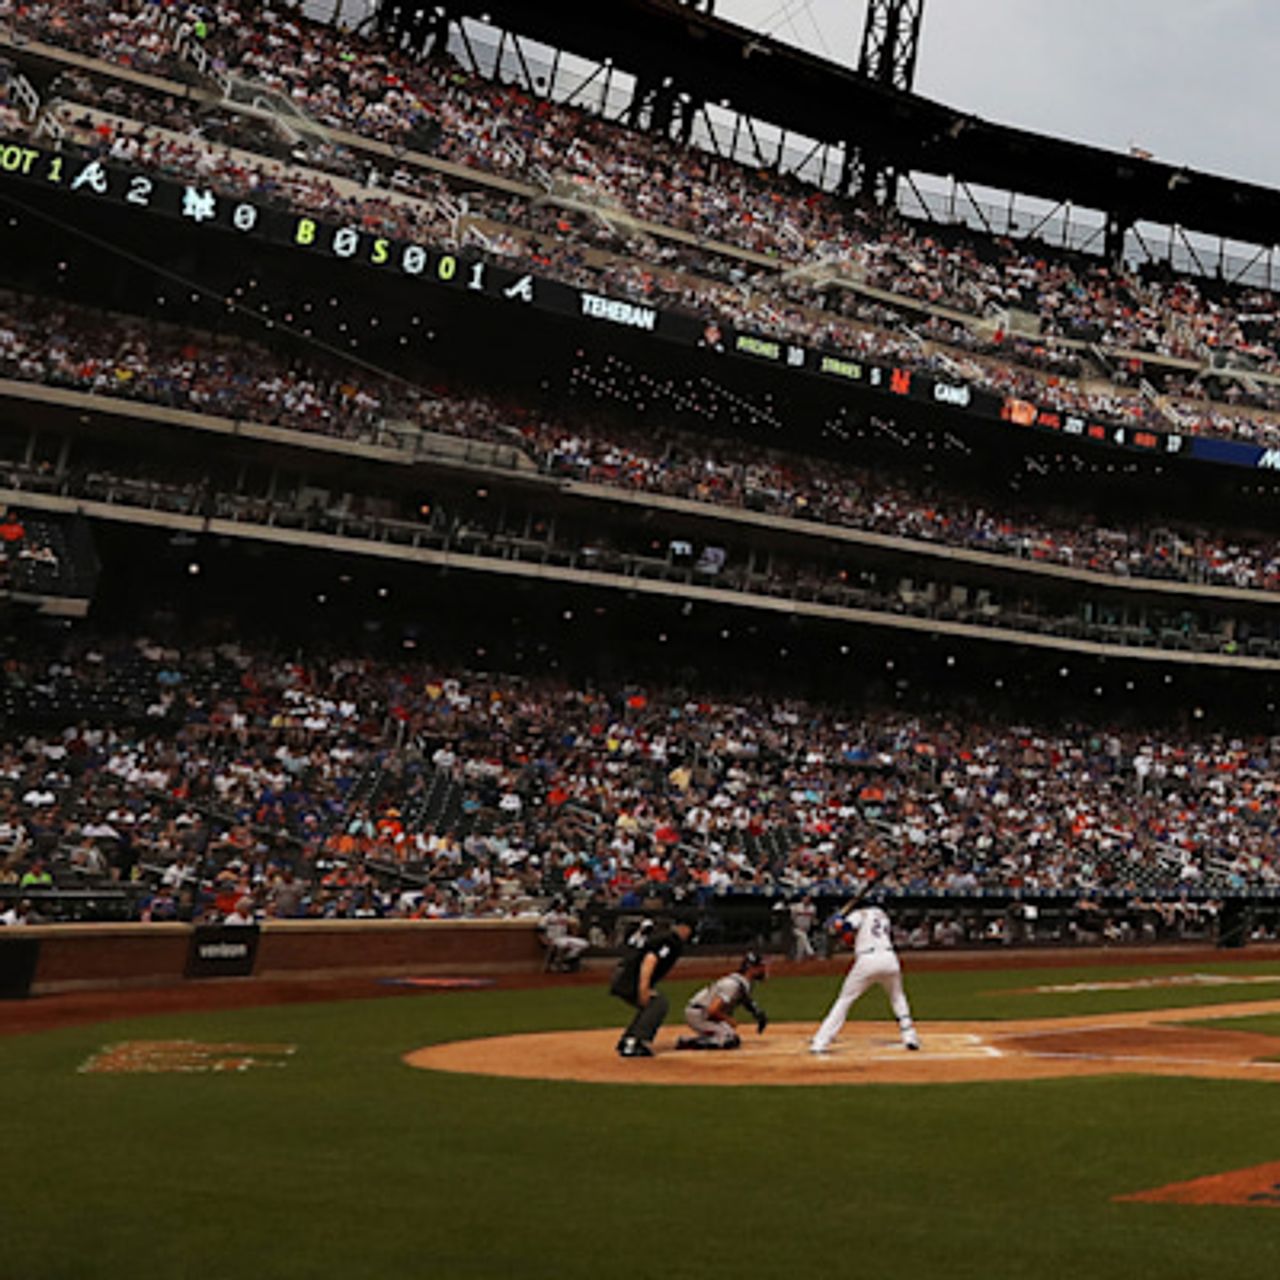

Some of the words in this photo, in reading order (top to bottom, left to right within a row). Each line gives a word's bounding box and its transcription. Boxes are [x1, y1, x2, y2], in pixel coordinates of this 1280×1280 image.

[0, 144, 39, 175] OT
[47, 156, 62, 182] 1
[126, 176, 152, 206] 2
[233, 203, 257, 231] 0
[296, 218, 316, 246] B
[333, 228, 358, 258] 0
[371, 238, 389, 265] S
[403, 246, 427, 276] 0
[468, 262, 485, 290] 1
[580, 292, 656, 331] TEHERAN
